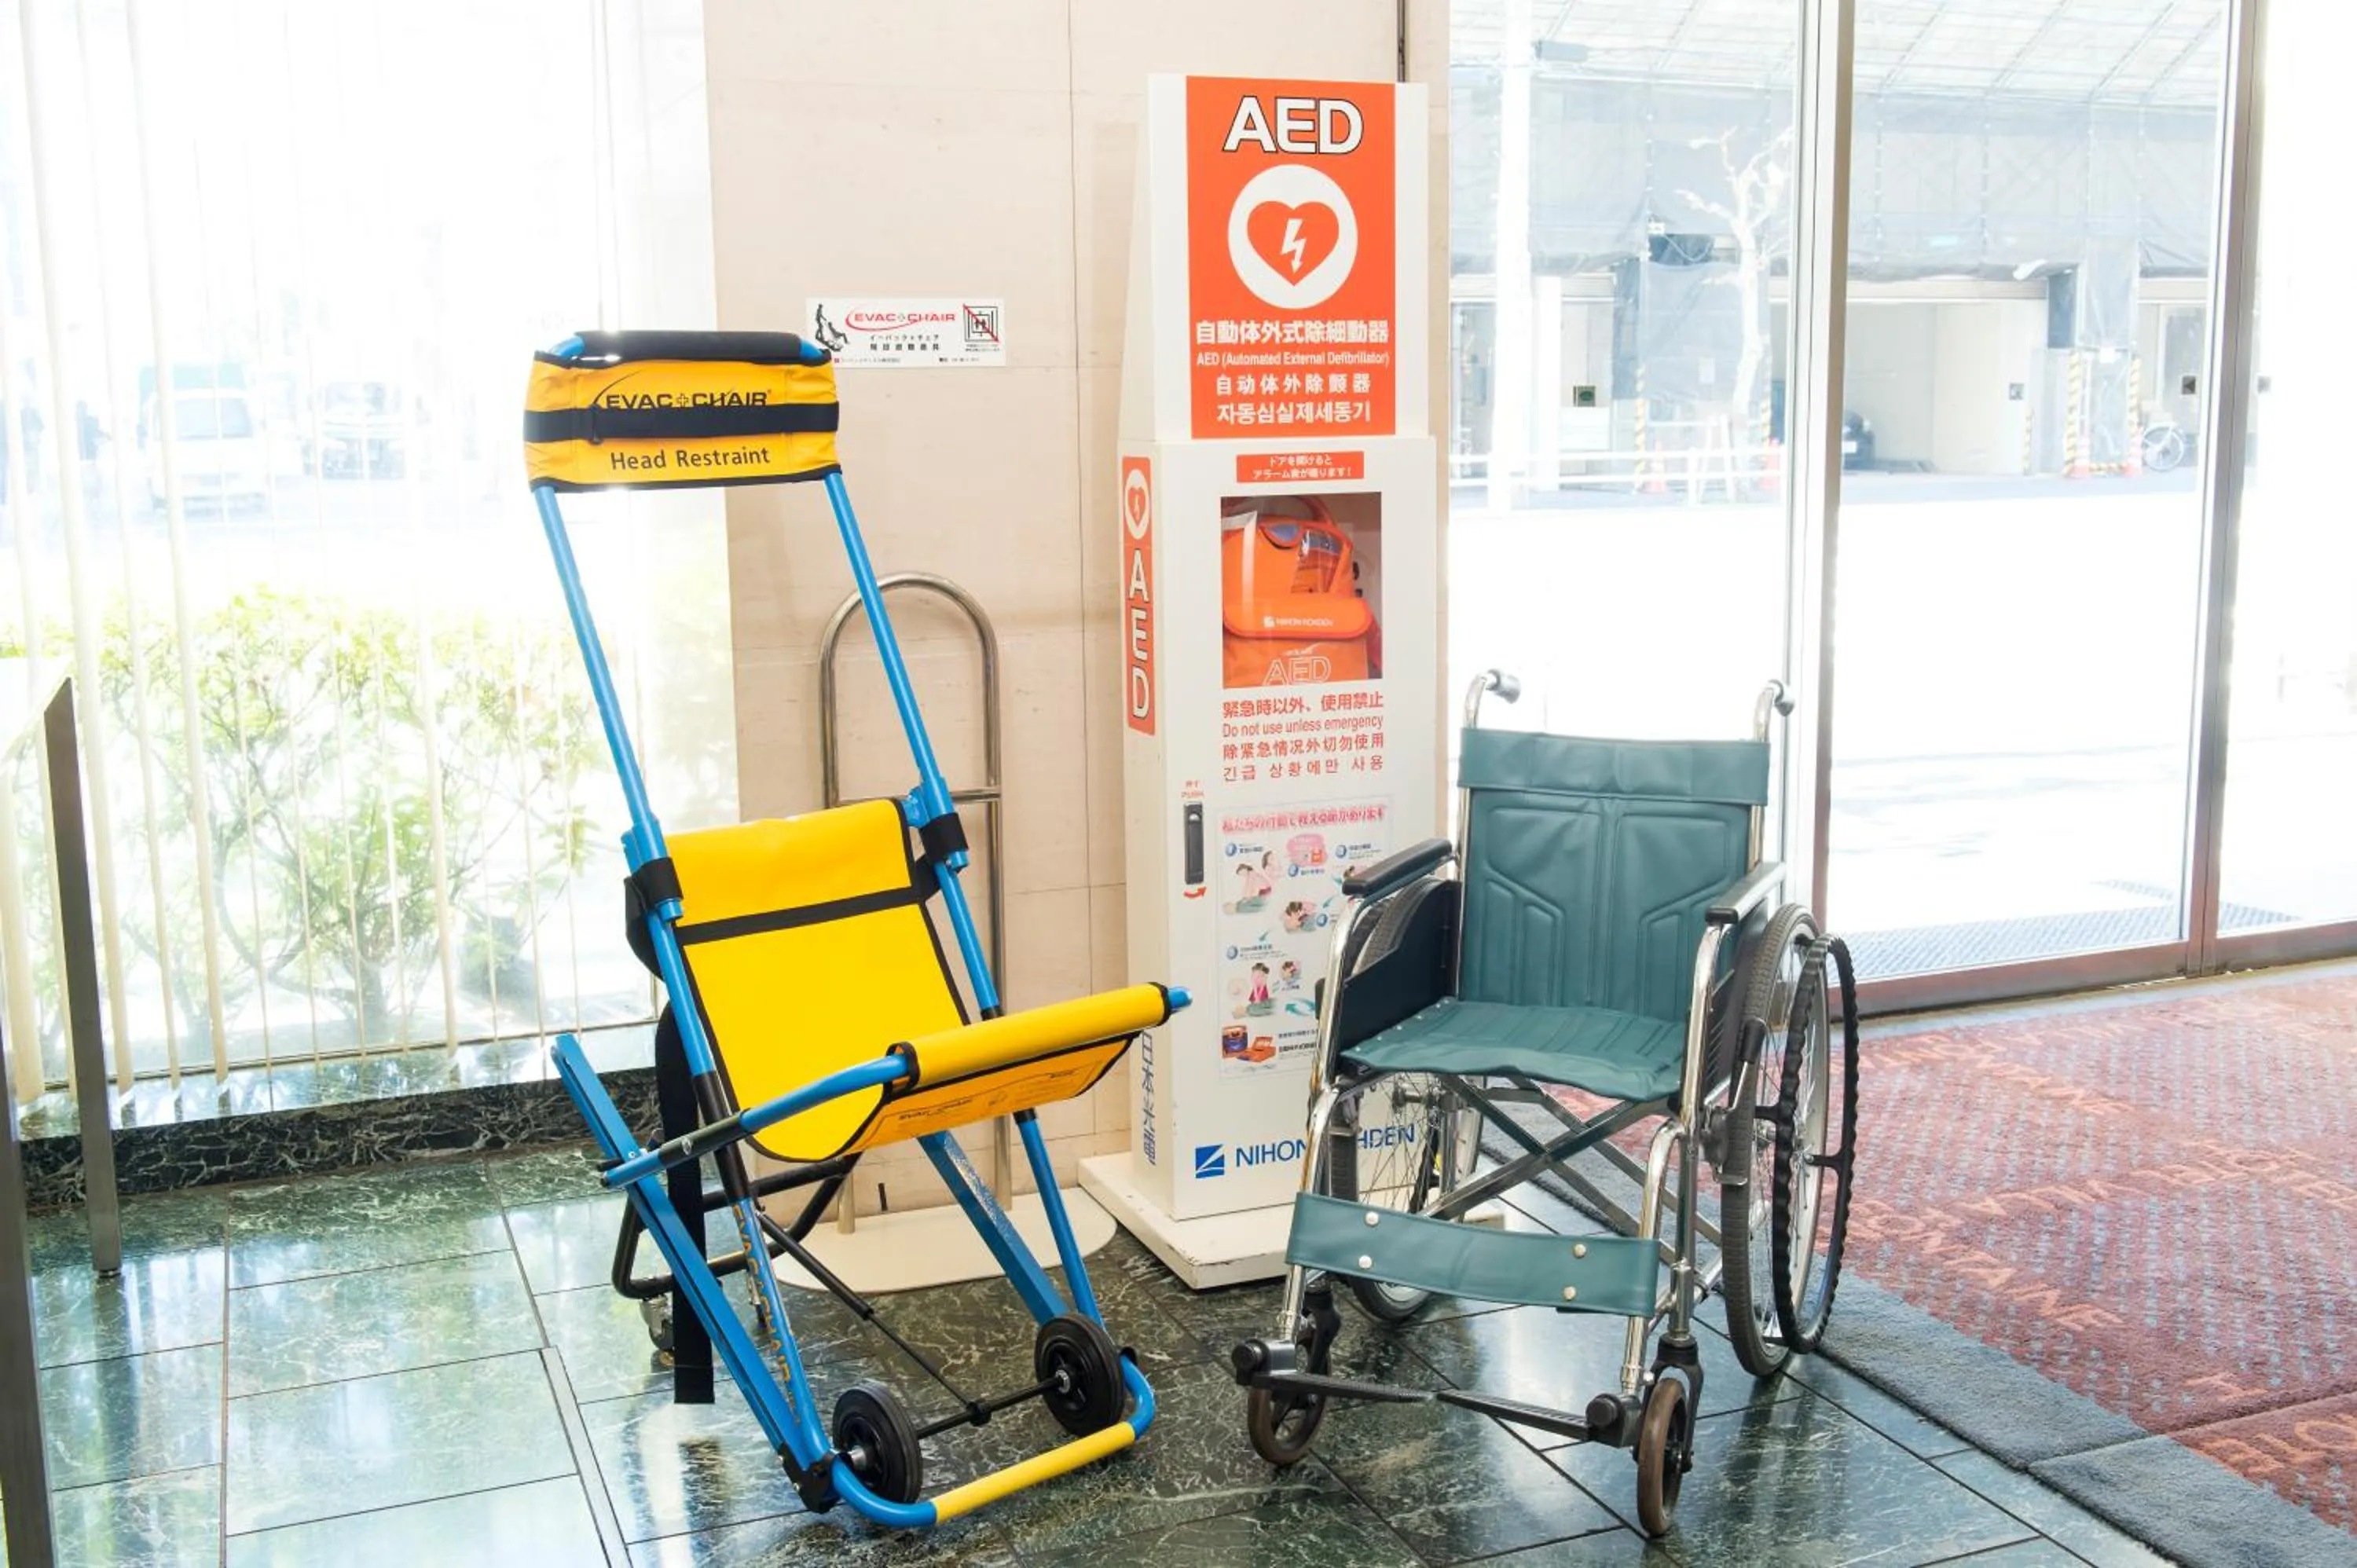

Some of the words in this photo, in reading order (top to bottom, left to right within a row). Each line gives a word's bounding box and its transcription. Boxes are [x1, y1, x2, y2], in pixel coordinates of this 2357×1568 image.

[1222, 94, 1365, 155] AED
[1196, 320, 1389, 344] 自動体外式除細動器
[1197, 353, 1219, 365] AED
[1222, 352, 1281, 369] (Automated
[1283, 351, 1325, 365] External
[1328, 350, 1390, 369] Defibrillator)
[1217, 401, 1371, 425] 자동심실제세동기
[610, 449, 666, 471] Head
[676, 446, 770, 467] Restraint
[1128, 547, 1150, 721] AED
[1264, 657, 1331, 686] AED
[1222, 723, 1237, 738] Do
[1241, 722, 1259, 736] not
[1263, 721, 1282, 735] use
[1285, 718, 1322, 733] unless
[1324, 715, 1384, 732] emergency
[1351, 754, 1384, 772] 사용
[1235, 1140, 1307, 1167] NIHON
[1358, 1123, 1416, 1150] HDEN
